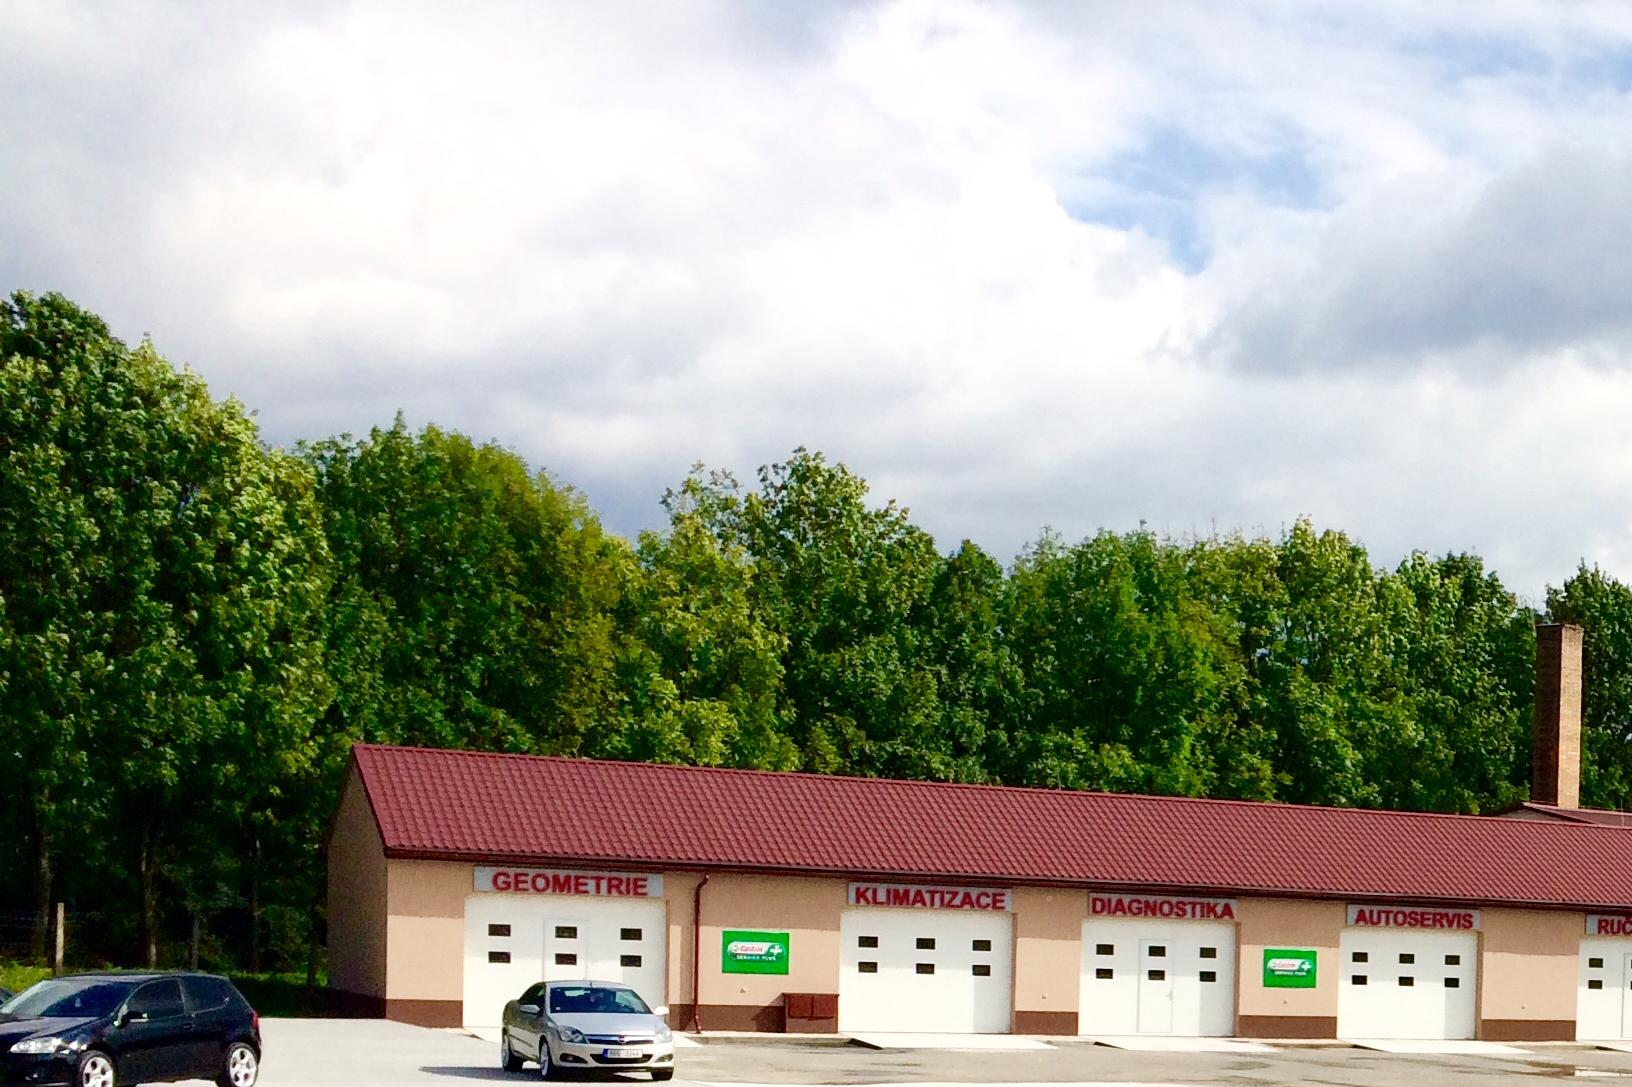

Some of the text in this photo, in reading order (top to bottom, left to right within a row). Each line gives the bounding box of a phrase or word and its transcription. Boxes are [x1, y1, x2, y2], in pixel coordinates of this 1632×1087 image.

[491, 871, 649, 896] GEOMETRIE
[854, 885, 1008, 911] KLIMATIZACE
[1091, 898, 1235, 920] DIAGNOSTIKA
[1354, 908, 1474, 929] AUTOSERVIS
